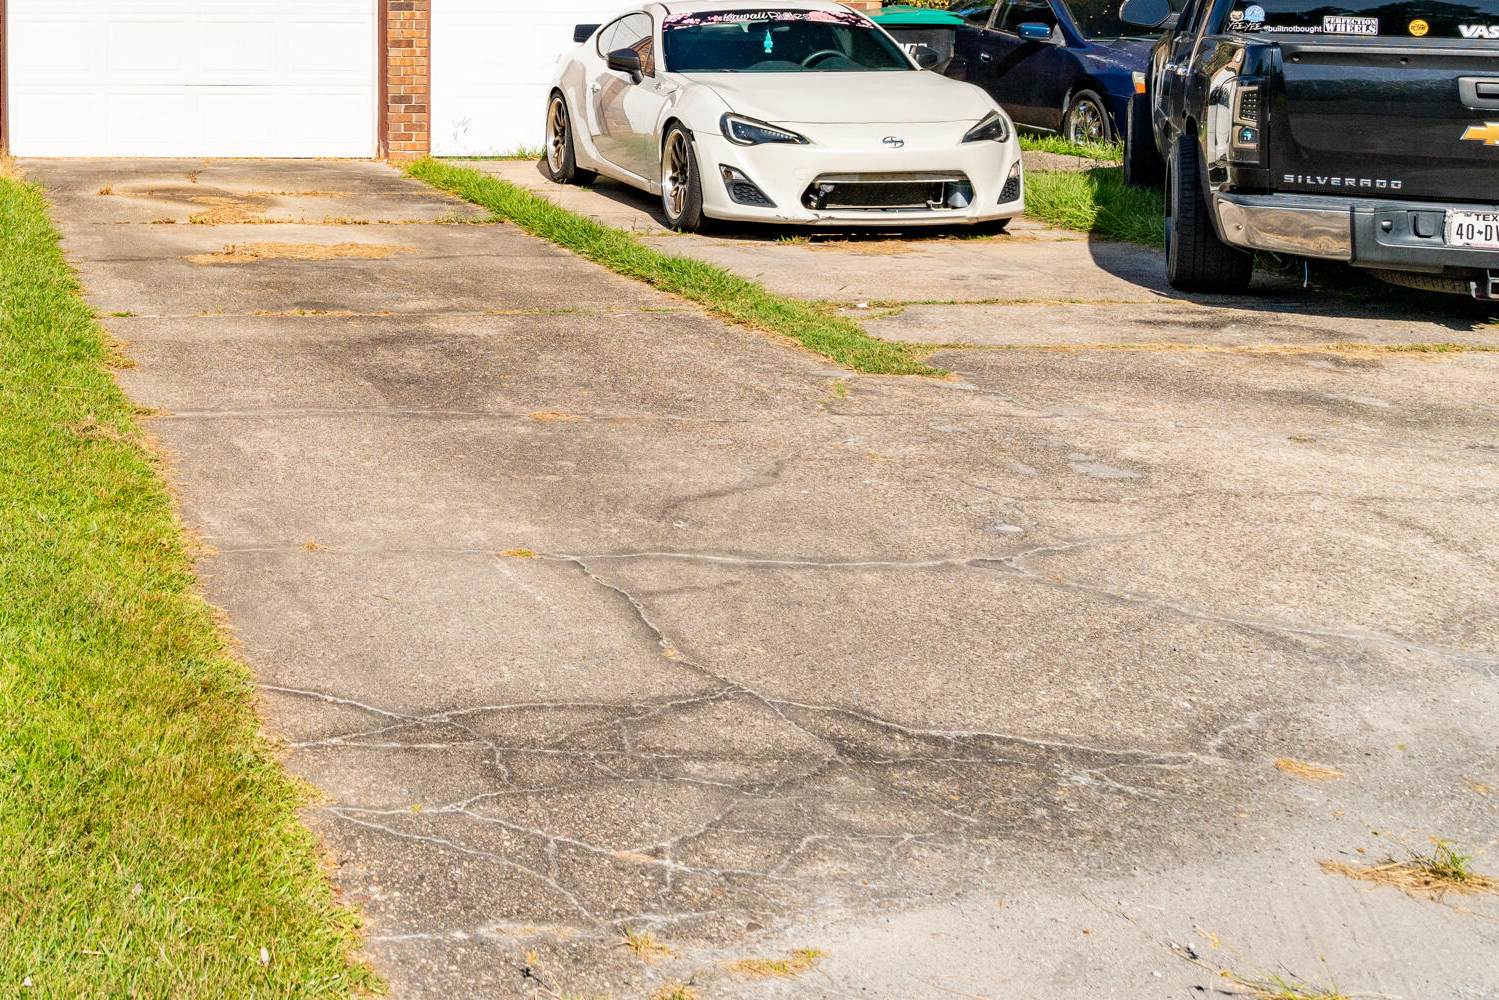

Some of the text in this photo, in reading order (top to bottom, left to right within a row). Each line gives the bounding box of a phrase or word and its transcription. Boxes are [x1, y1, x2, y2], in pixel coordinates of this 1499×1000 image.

[1325, 17, 1377, 25] PERFECTION
[1325, 23, 1377, 34] WHEELS
[1283, 174, 1402, 189] SILVERADO
